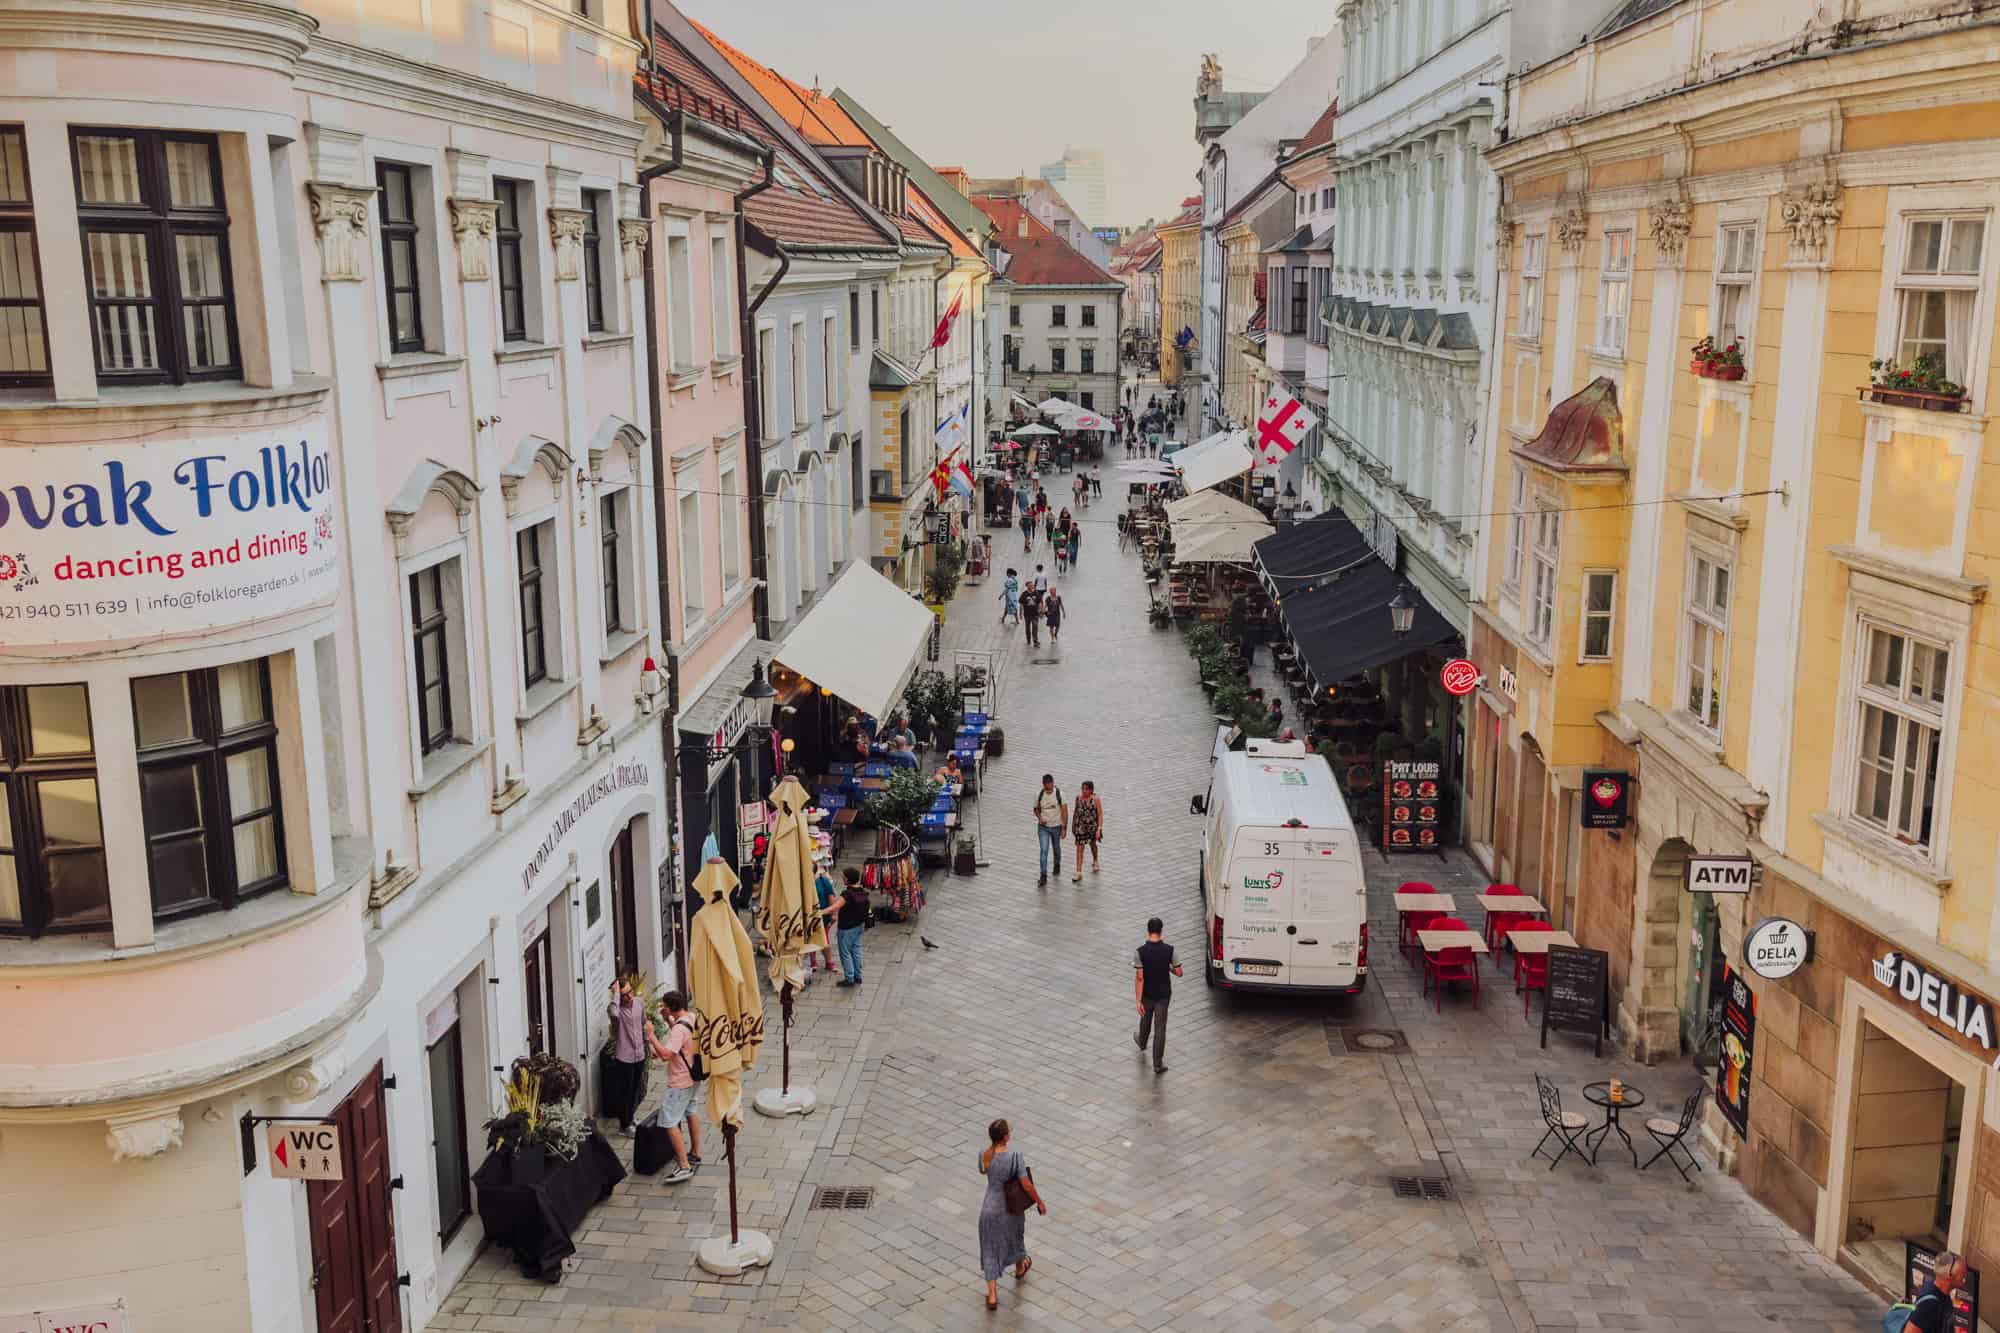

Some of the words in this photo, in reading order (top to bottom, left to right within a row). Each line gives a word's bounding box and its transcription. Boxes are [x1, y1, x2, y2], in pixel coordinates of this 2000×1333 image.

[53, 550, 184, 579] dancing
[190, 539, 241, 569] and
[247, 530, 308, 560] dining
[26, 604, 61, 619] 940
[65, 602, 91, 617] 511
[95, 599, 128, 615] 639
[147, 574, 300, 610] info@folkloregarden.sk
[1264, 842, 1280, 856] 35
[1695, 867, 1748, 884] ATM
[1757, 947, 1798, 960] DELIA
[1899, 959, 1990, 1050] DELIA
[290, 1130, 334, 1151] WC
